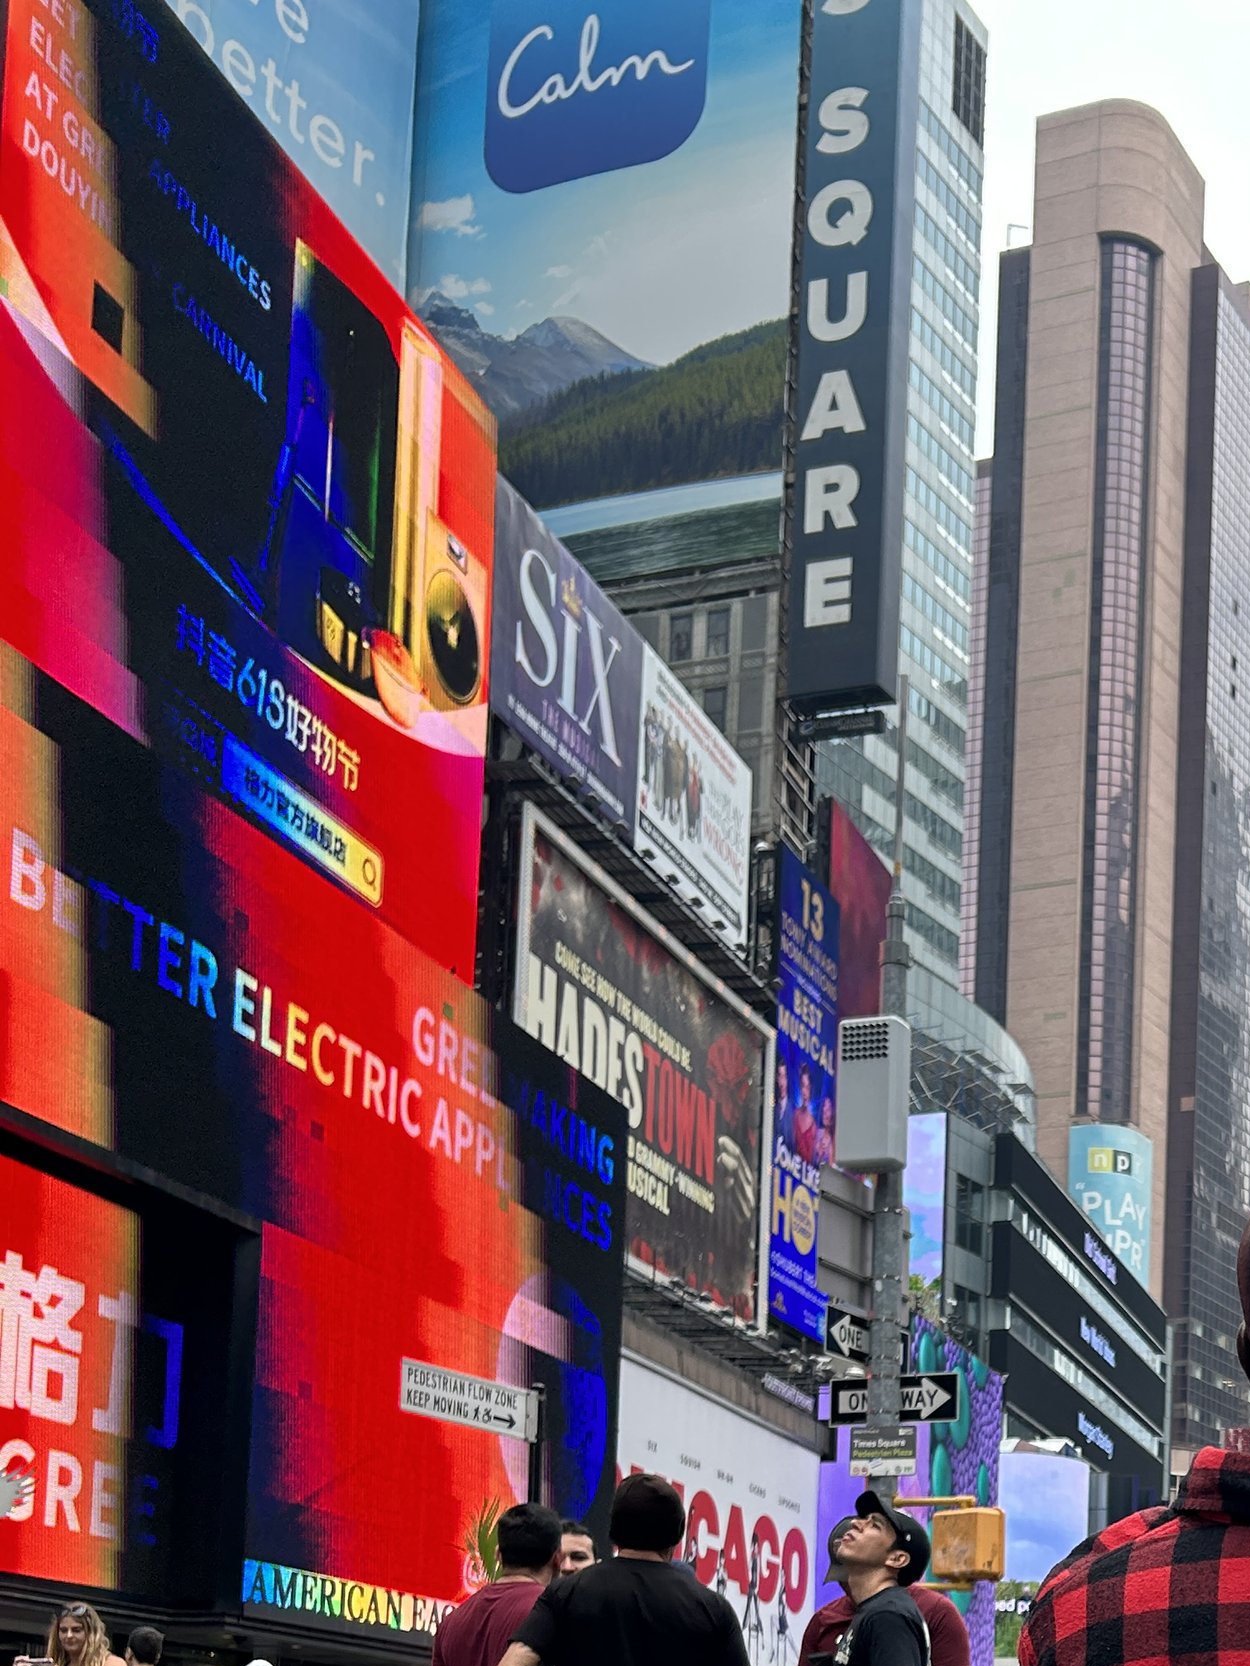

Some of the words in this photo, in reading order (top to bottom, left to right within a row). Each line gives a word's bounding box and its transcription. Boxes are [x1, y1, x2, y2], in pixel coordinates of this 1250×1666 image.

[497, 14, 695, 118] Calm
[24, 70, 59, 121] AT
[800, 86, 874, 629] SQUARE
[514, 548, 622, 769] SIX
[801, 878, 825, 942] 13
[555, 939, 580, 982] COME
[580, 961, 596, 995] SEE
[793, 988, 824, 1034] BEST
[232, 966, 423, 1139] ELECTRIC
[777, 1004, 835, 1077] MUSICAL
[627, 1163, 671, 1217] USICAL
[838, 1323, 863, 1349] ONE
[406, 1388, 431, 1409] KEEP
[432, 1395, 469, 1418] MOVING
[407, 1366, 466, 1397] PEDESTRIAN
[467, 1384, 493, 1404] FLOW
[494, 1391, 518, 1410] ZONE
[849, 1392, 869, 1411] ON
[900, 1388, 939, 1411] WAY
[853, 1439, 876, 1450] Times
[877, 1438, 906, 1450] Square
[249, 1562, 402, 1629] AMERICAN
